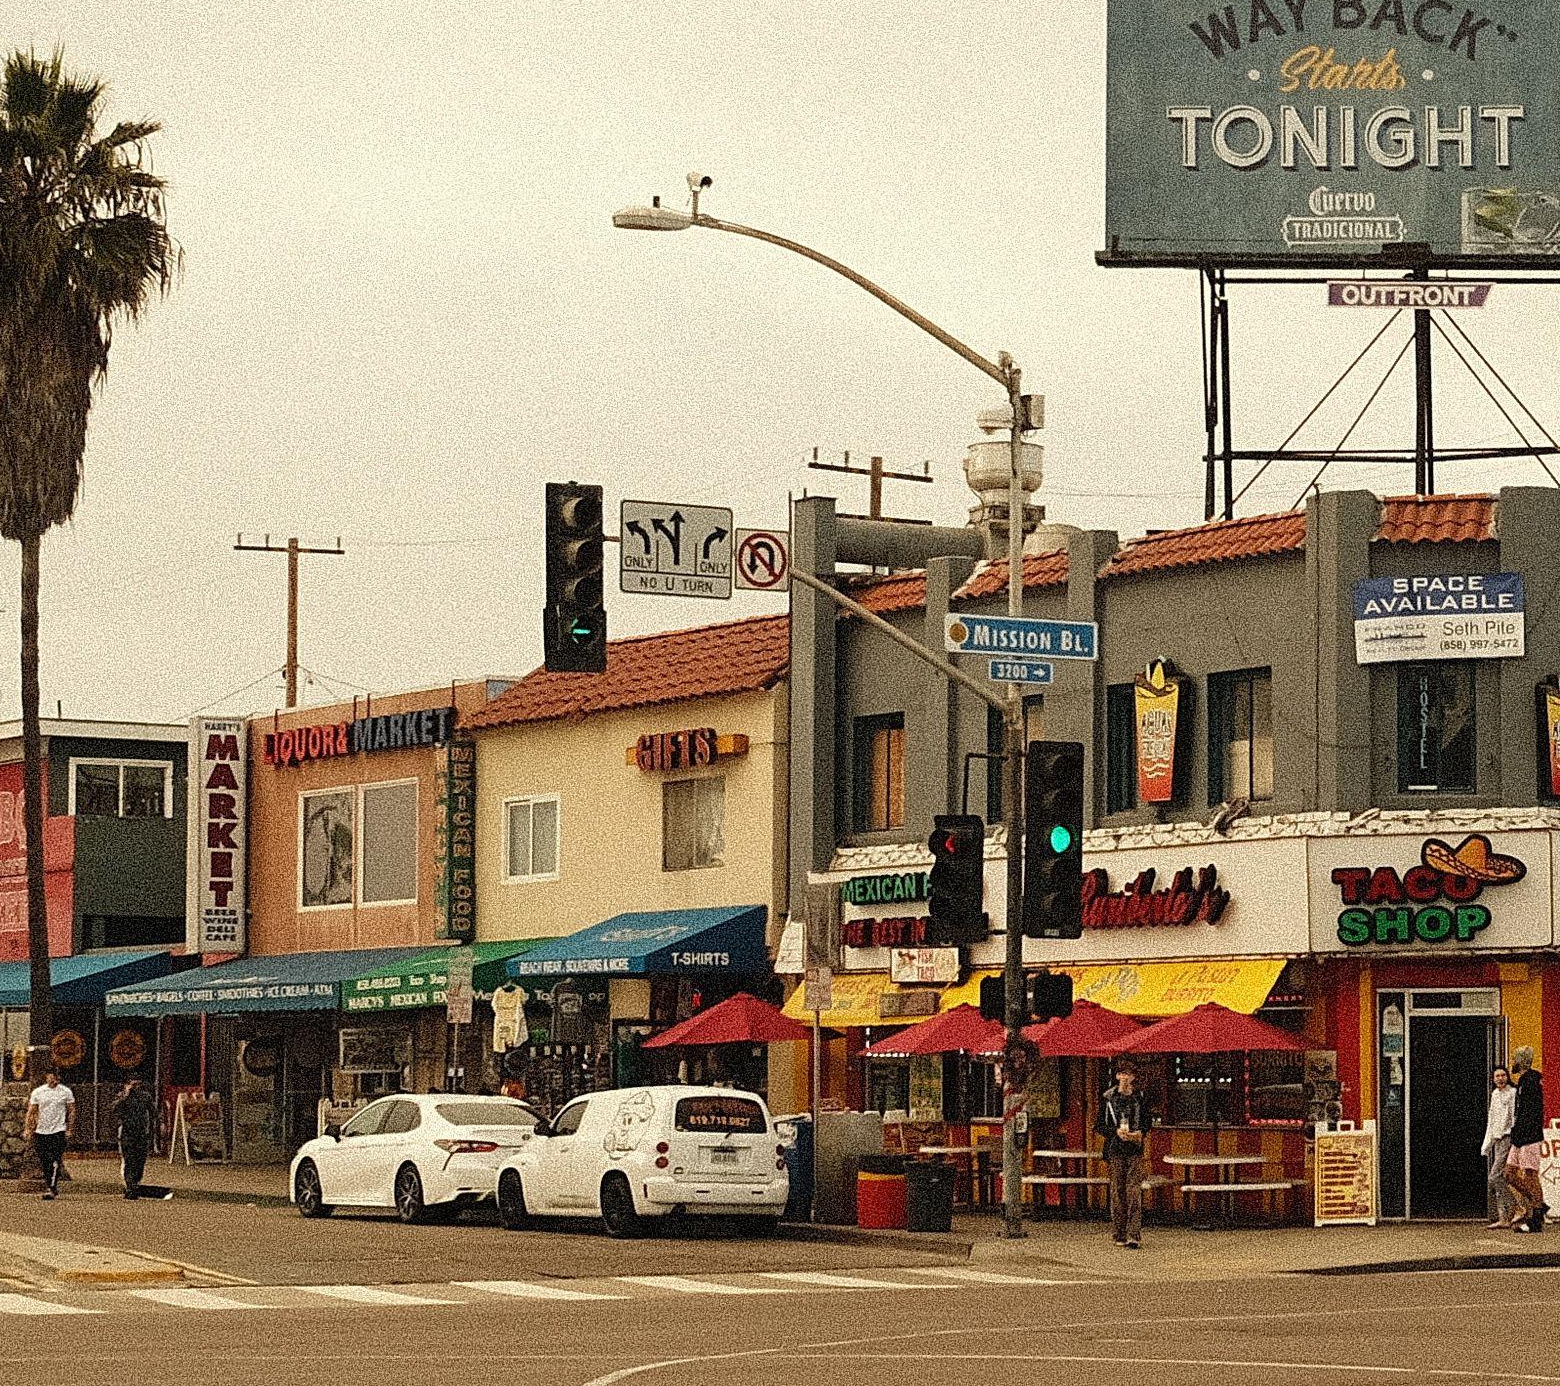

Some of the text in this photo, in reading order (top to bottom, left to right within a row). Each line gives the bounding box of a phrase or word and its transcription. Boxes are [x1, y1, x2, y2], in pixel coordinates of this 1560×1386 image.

[1279, 45, 1406, 94] Starts
[1166, 103, 1525, 169] TONIGHT
[1308, 185, 1376, 215] Cuervo
[1292, 221, 1394, 239] TRADICIONAL
[1341, 285, 1476, 305] OUTFRONT
[625, 556, 653, 568] ONLY
[700, 561, 729, 574] ONLY
[640, 576, 713, 593] NO U TURN
[1393, 576, 1484, 594] SPACE
[1363, 593, 1515, 615] AVAILABLE
[973, 625, 1052, 651] MISSION
[1442, 621, 1479, 637] Seth
[1440, 640, 1467, 653] (858)
[997, 664, 1028, 680] 3200
[352, 708, 449, 753] MARKET
[636, 727, 717, 772] GIFTS
[205, 734, 239, 907] MARKET
[842, 875, 915, 902] MEXICAN
[1334, 868, 1482, 903] TACO
[203, 917, 238, 926] WINE
[206, 925, 235, 934] DELI
[1338, 907, 1490, 946] SHOP
[672, 951, 730, 966] T-SHIRTS
